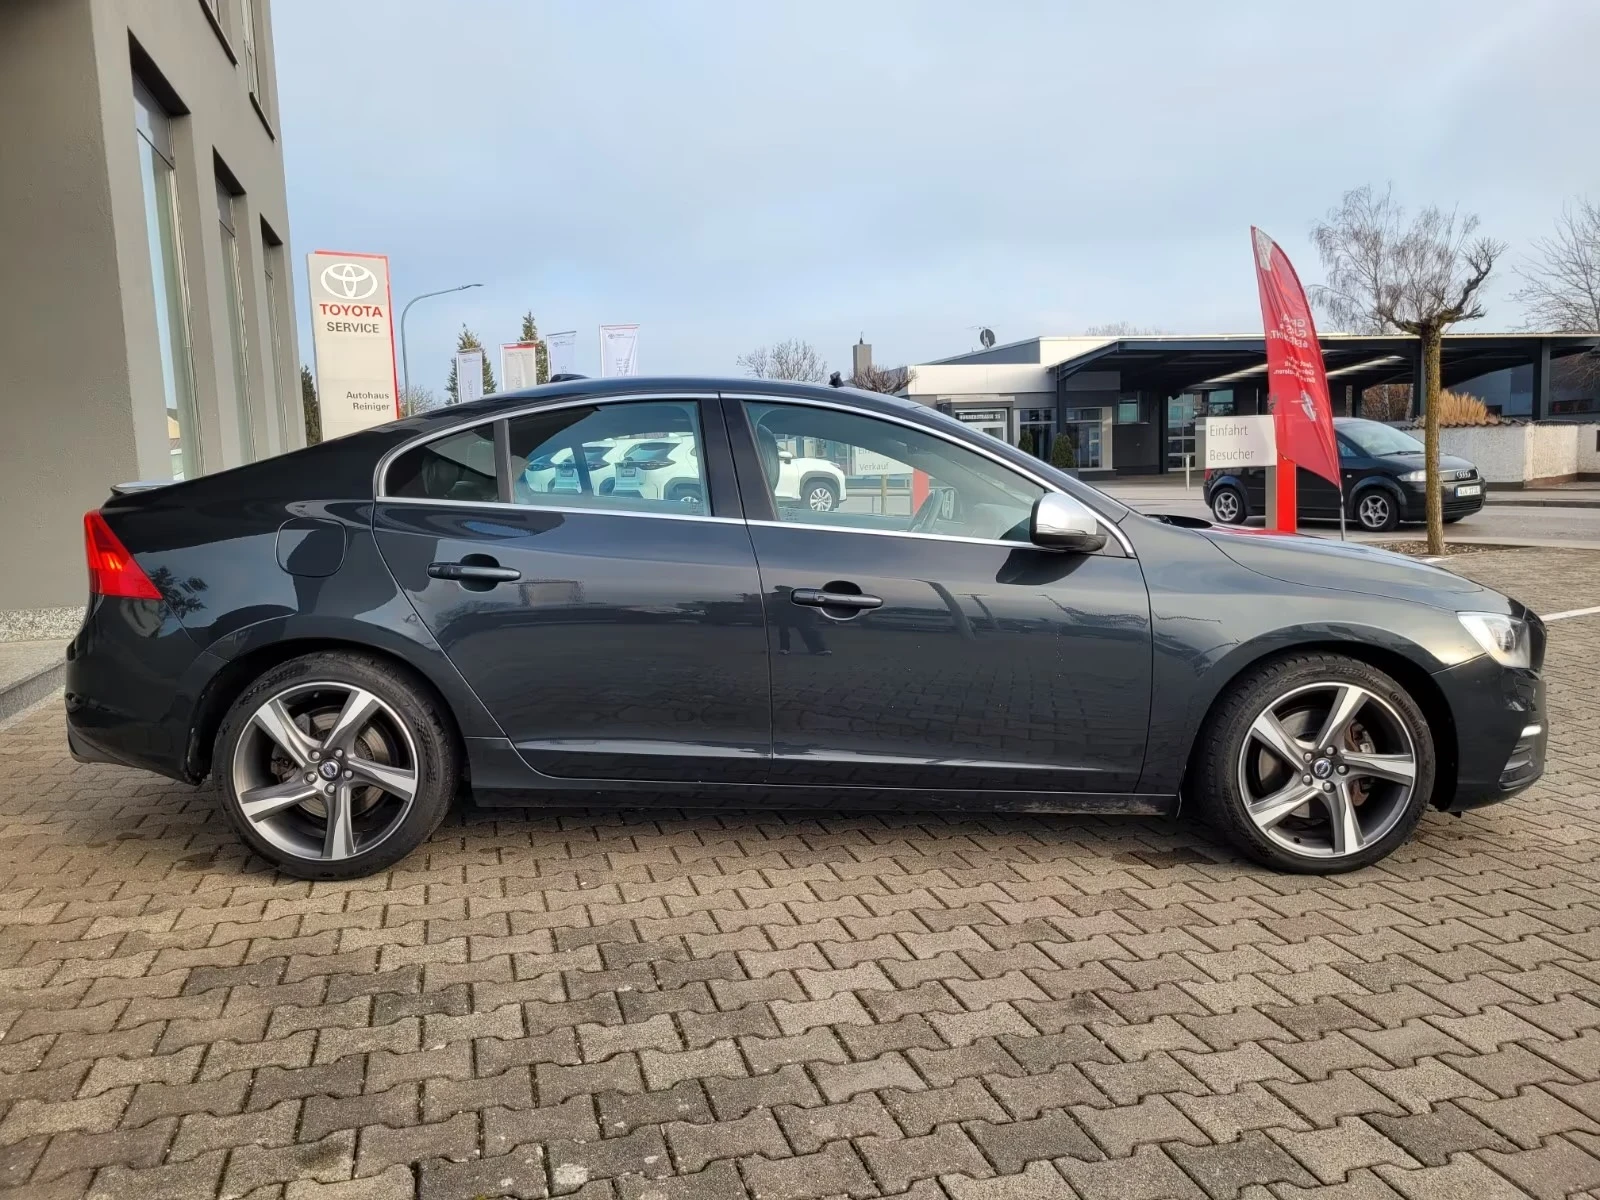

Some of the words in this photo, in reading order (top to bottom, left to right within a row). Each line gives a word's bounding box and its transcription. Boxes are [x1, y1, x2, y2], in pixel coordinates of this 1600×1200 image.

[319, 303, 383, 317] TOYOTA
[326, 321, 380, 333] SERVICE
[346, 391, 389, 400] Autohaus
[352, 402, 390, 411] Reiniger
[1209, 423, 1249, 437] Einfahrt
[1209, 448, 1255, 461] Besucher
[859, 462, 889, 471] Verkauf
